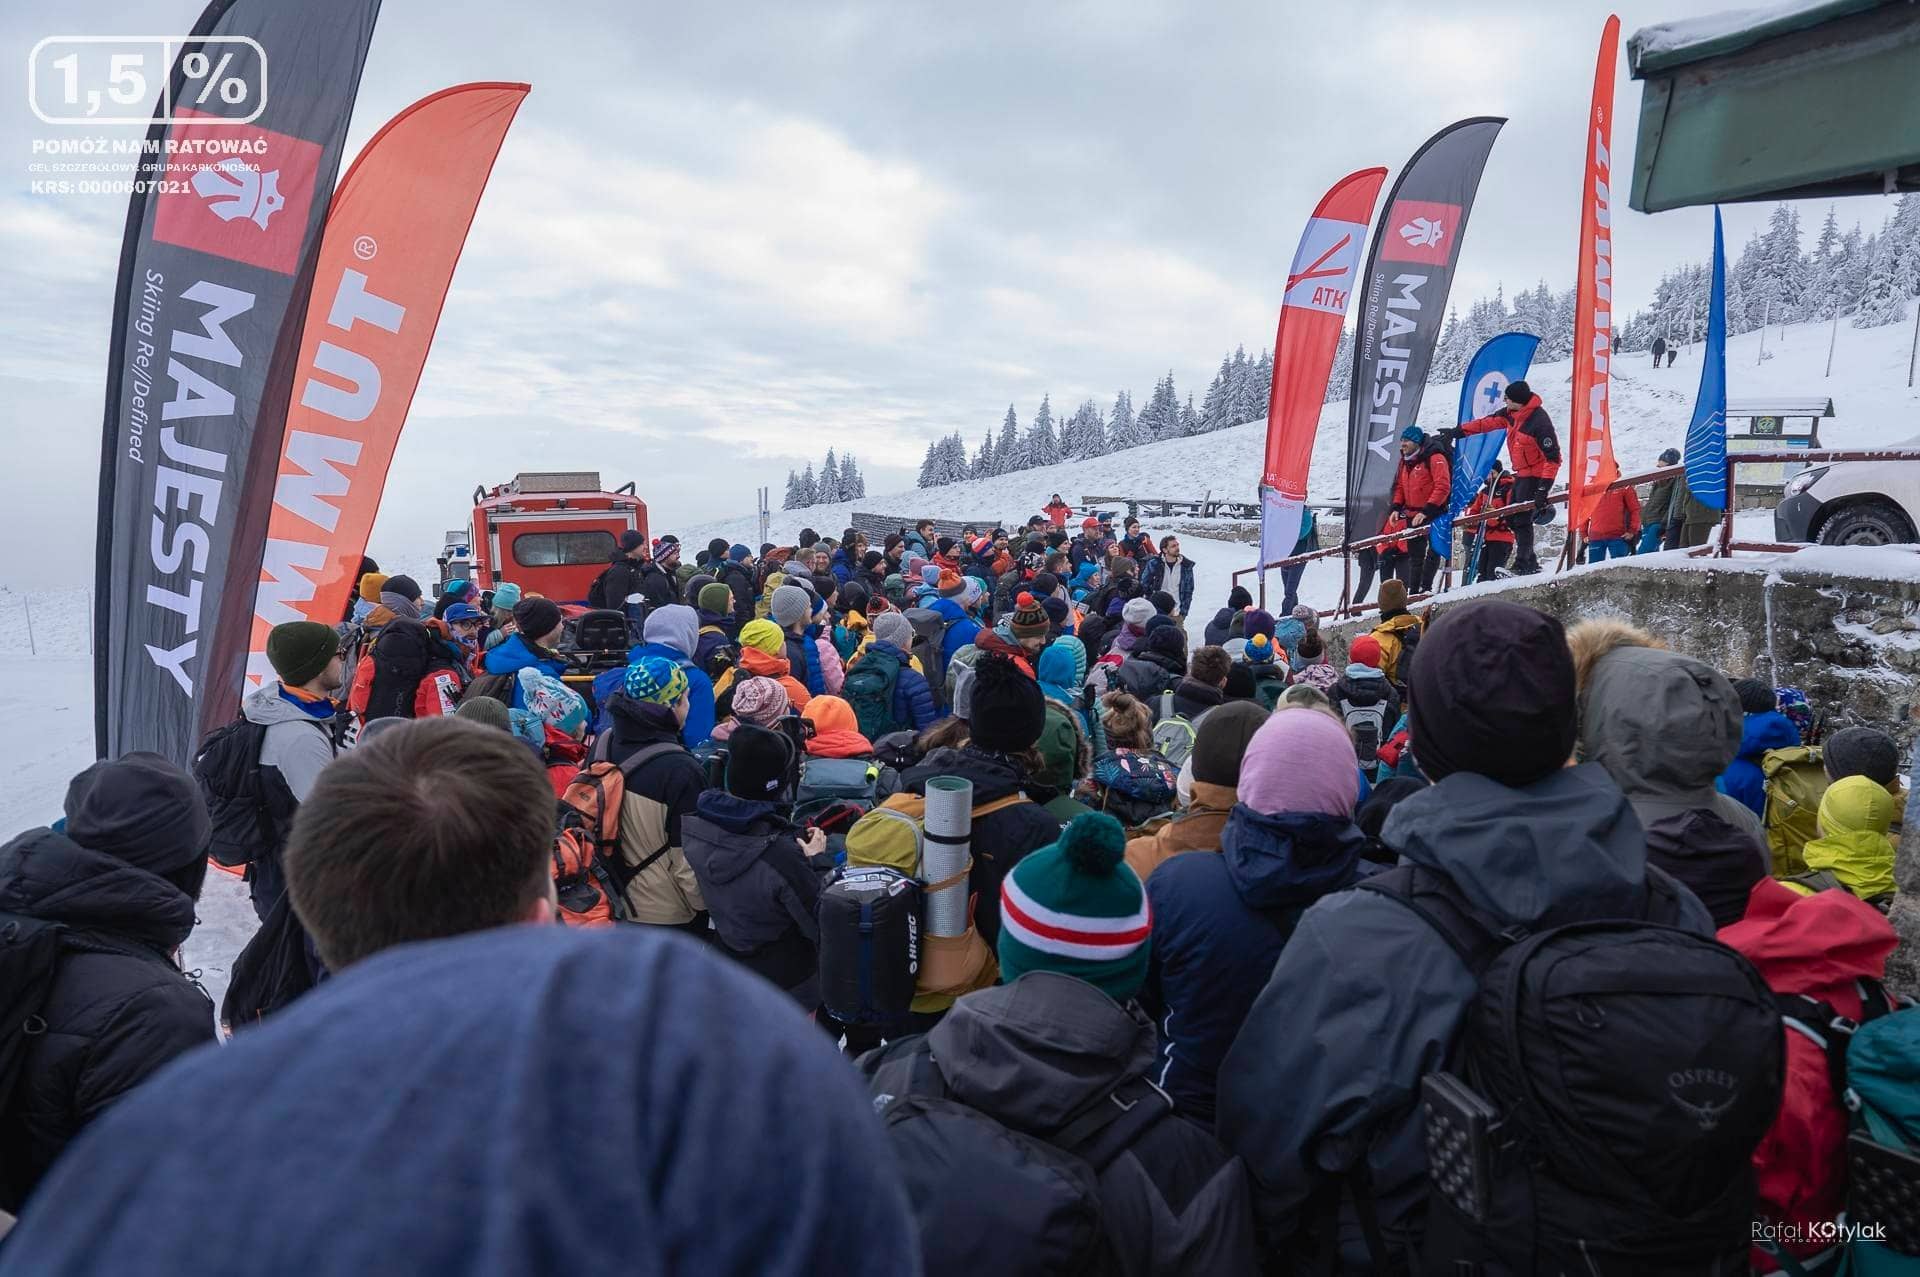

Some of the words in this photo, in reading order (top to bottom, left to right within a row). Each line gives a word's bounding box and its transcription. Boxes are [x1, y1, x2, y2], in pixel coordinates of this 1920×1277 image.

[134, 268, 163, 337] Skiing
[1312, 286, 1348, 309] ATK
[1370, 273, 1385, 302] Skiing
[1367, 273, 1428, 462] MAJESTY
[144, 280, 256, 698] MAJESTY
